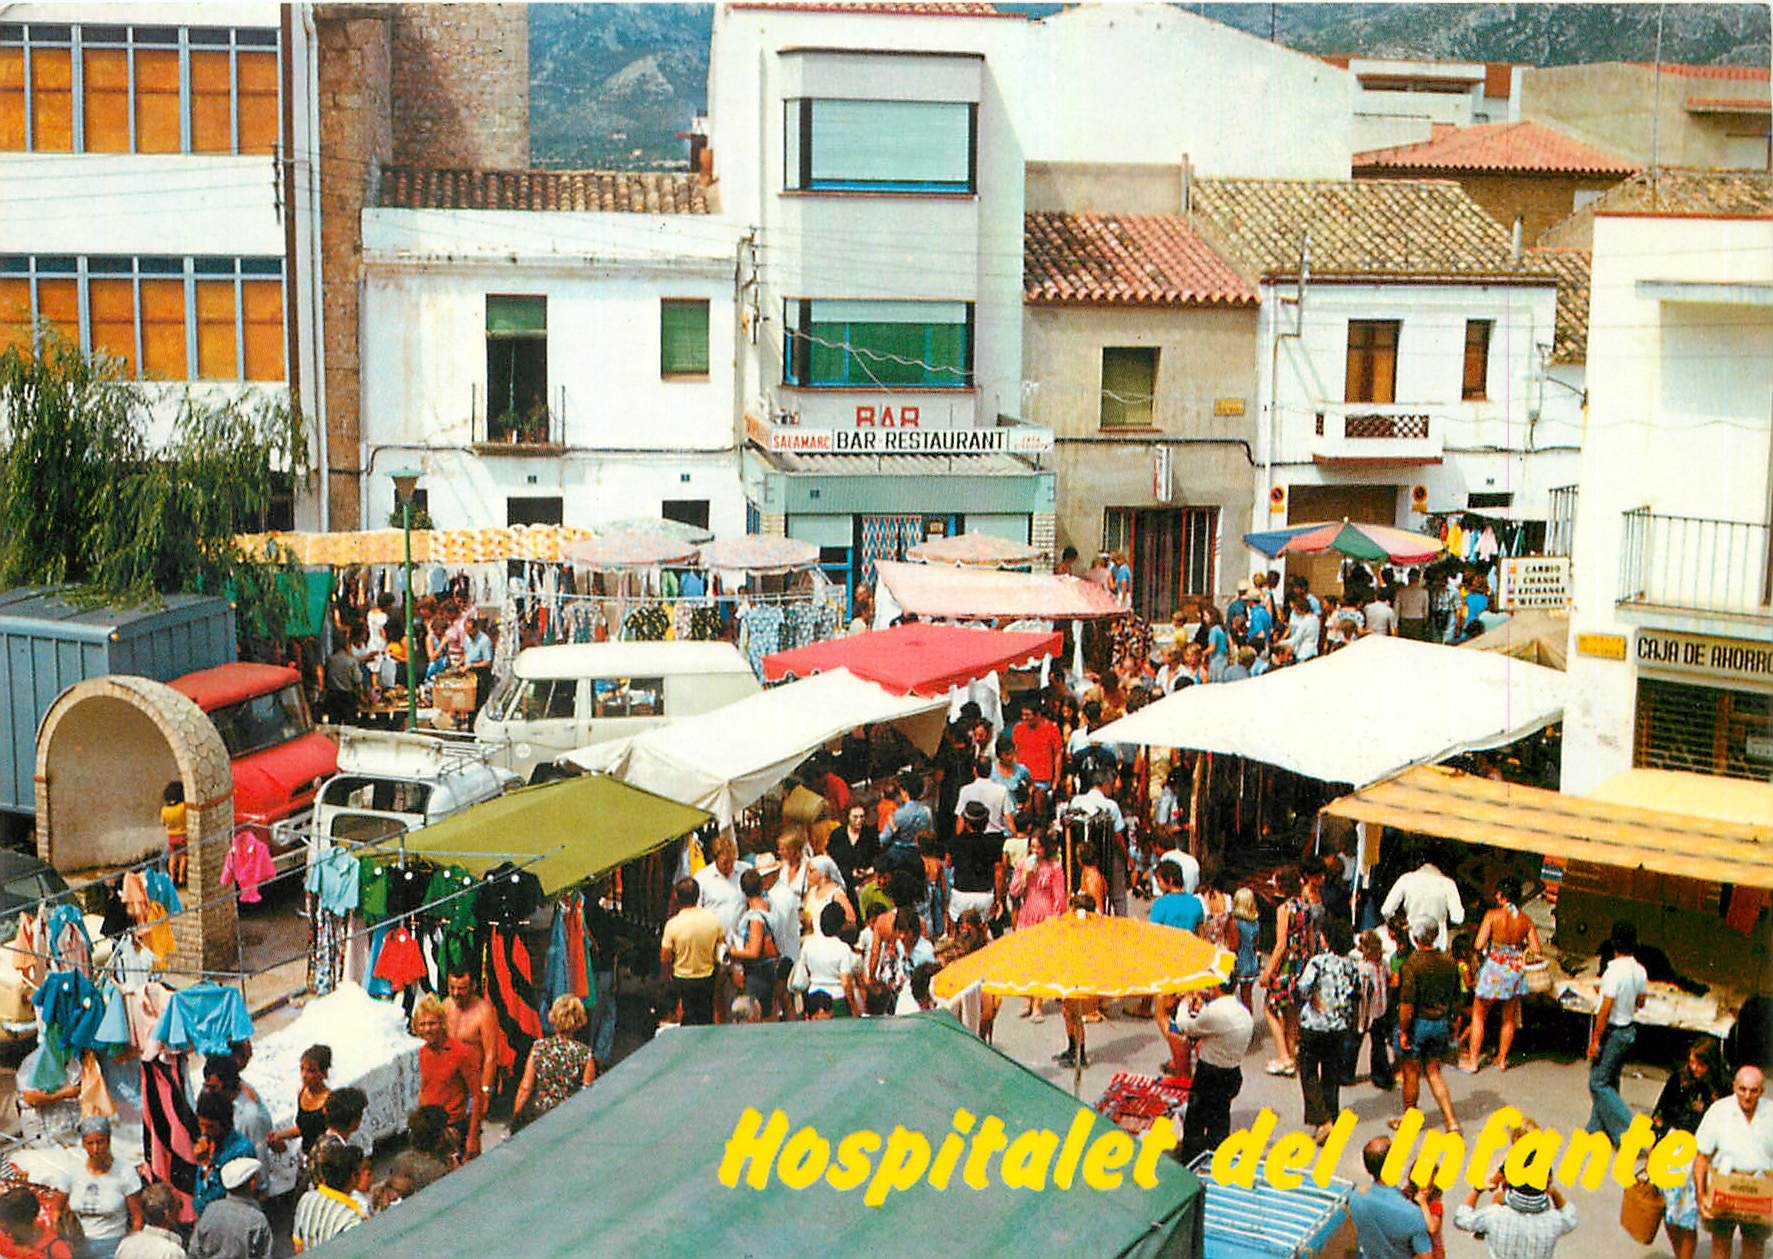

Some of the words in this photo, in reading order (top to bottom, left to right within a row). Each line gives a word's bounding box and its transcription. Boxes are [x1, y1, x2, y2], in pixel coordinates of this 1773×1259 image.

[856, 406, 919, 427] BAR
[837, 432, 876, 450] BAR
[885, 432, 1005, 450] RESTAURANT
[1525, 565, 1561, 574] CAMBIO
[1523, 576, 1560, 584] CHANGE
[1637, 637, 1679, 662] CAJA
[1684, 642, 1706, 666] DE
